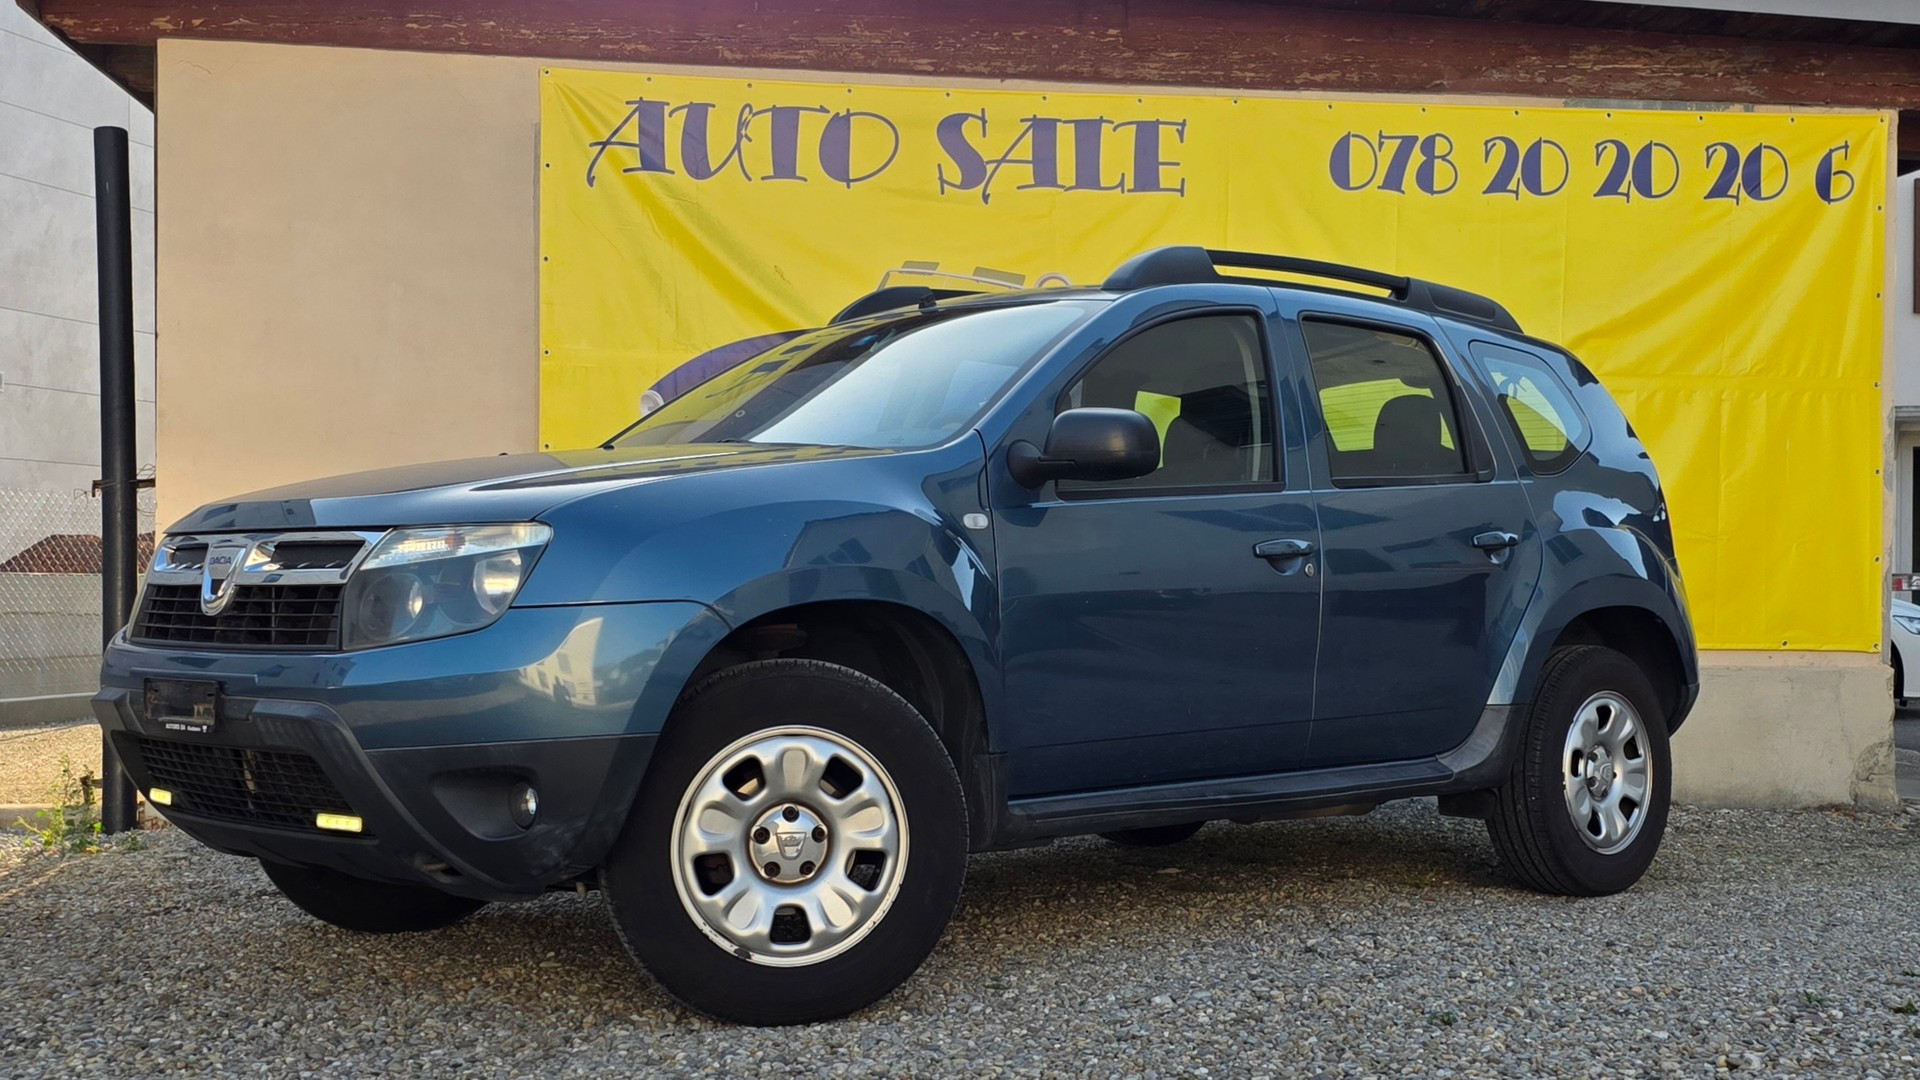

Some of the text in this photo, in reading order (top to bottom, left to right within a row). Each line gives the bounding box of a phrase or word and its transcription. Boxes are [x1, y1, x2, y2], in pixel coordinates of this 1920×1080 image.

[586, 97, 1187, 206] AUTO SALE
[1328, 131, 1856, 206] 078 20 20 20 6
[209, 556, 232, 566] DACIA
